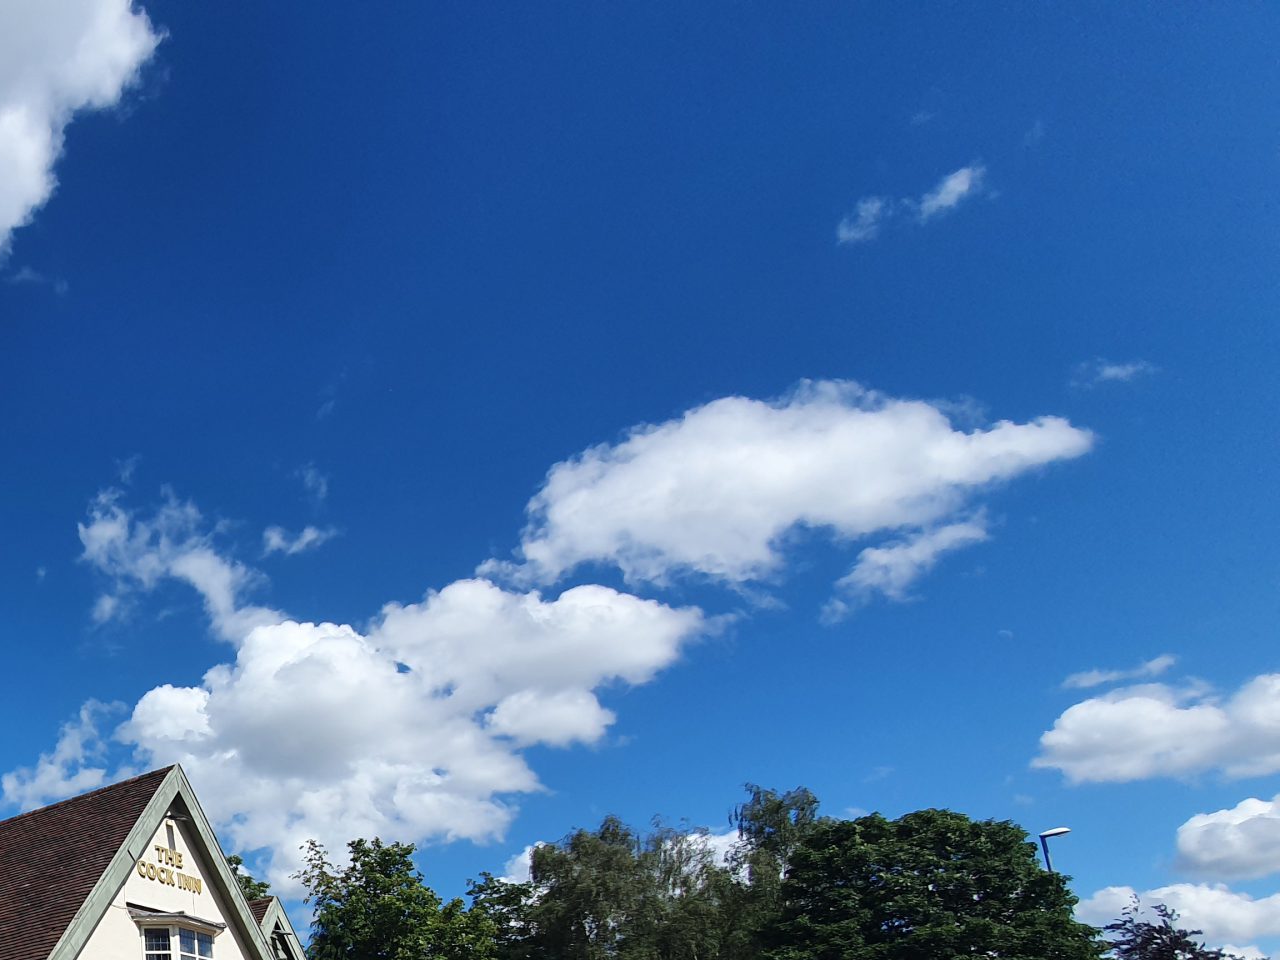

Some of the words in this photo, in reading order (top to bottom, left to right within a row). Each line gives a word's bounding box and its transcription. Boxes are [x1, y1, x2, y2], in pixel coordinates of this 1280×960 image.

[154, 844, 183, 869] THE
[136, 860, 175, 887] COCK
[177, 872, 202, 895] INN
